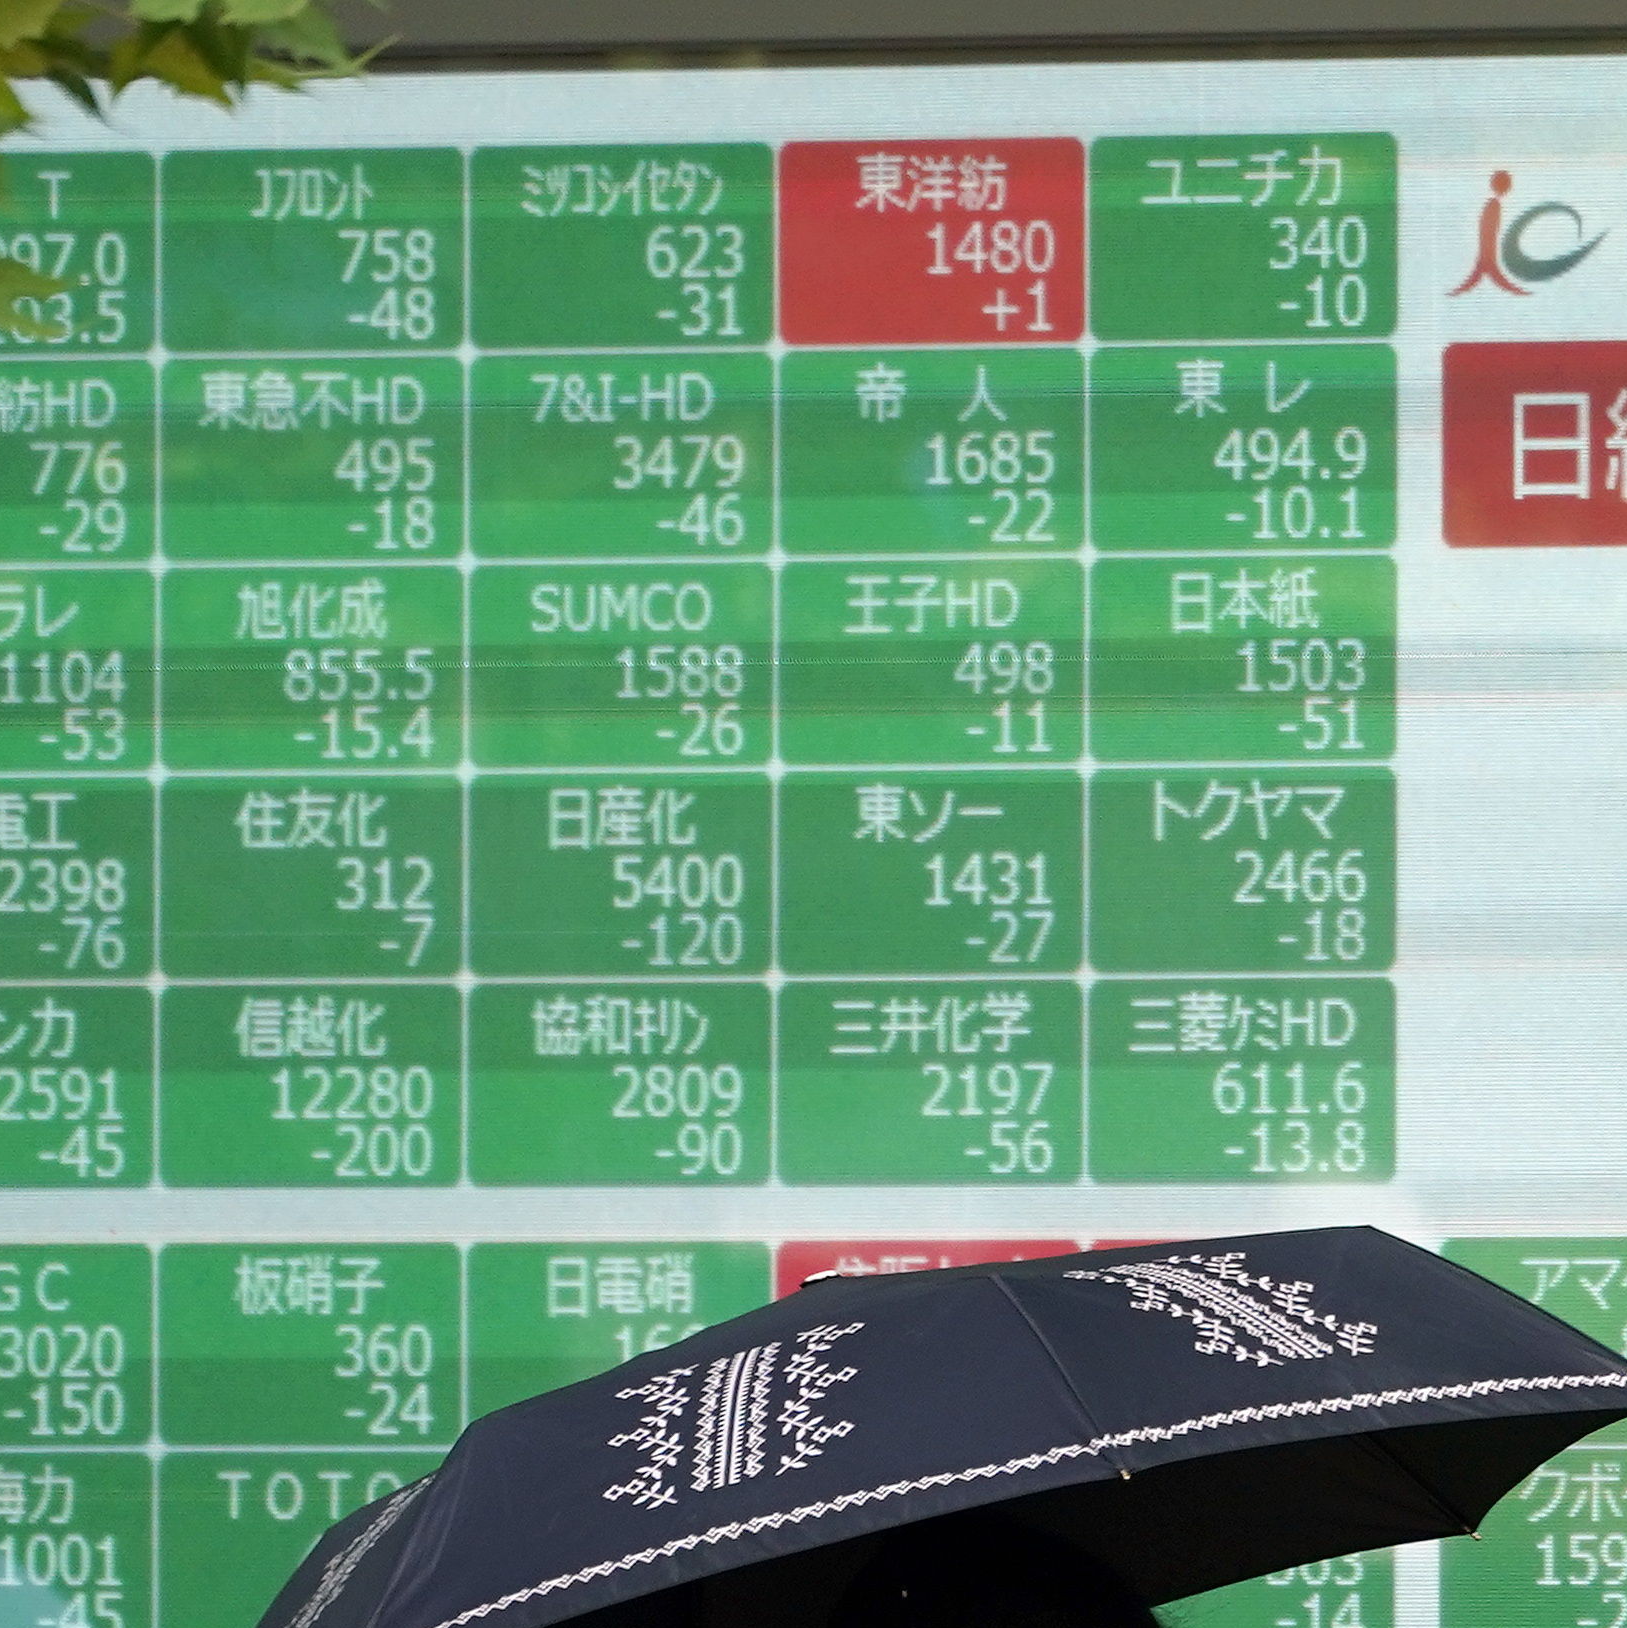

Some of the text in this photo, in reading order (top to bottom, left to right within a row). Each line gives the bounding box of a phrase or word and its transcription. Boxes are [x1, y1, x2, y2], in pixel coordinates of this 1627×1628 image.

[856, 153, 1006, 211] 東洋紡
[1141, 145, 1344, 207] ユニチカ
[928, 220, 1055, 275] 1480
[1269, 215, 1368, 270] 340
[982, 280, 1053, 332] +1
[1279, 273, 1367, 328] -10
[201, 369, 424, 430] 東急不HD
[30, 441, 127, 497] 776
[334, 437, 434, 493] 495
[614, 434, 747, 489] 3479
[38, 498, 127, 553] -29
[348, 494, 435, 550] -18
[657, 492, 745, 547] -46
[530, 581, 712, 633] SUMCO
[843, 574, 1020, 635] 王子HD
[616, 644, 743, 699] 1588
[954, 640, 1054, 694] 498
[656, 700, 744, 757] -26
[966, 700, 1052, 754] -11
[549, 785, 696, 848] 日産化
[1153, 780, 1344, 841] トクヤマ
[613, 854, 744, 909] 5400
[1234, 849, 1367, 904] 2466
[38, 916, 126, 970] -76
[622, 911, 743, 966] -120
[1278, 907, 1365, 961] -18
[235, 996, 386, 1058] 信越化
[830, 993, 1030, 1054] 三井化学
[271, 1065, 433, 1120] 12280
[921, 1061, 1054, 1117] 2197
[312, 1122, 433, 1177] -200
[965, 1120, 1053, 1174] -56
[235, 1256, 384, 1315] 板硝子
[335, 1323, 433, 1379] 360
[345, 1380, 434, 1436] -24
